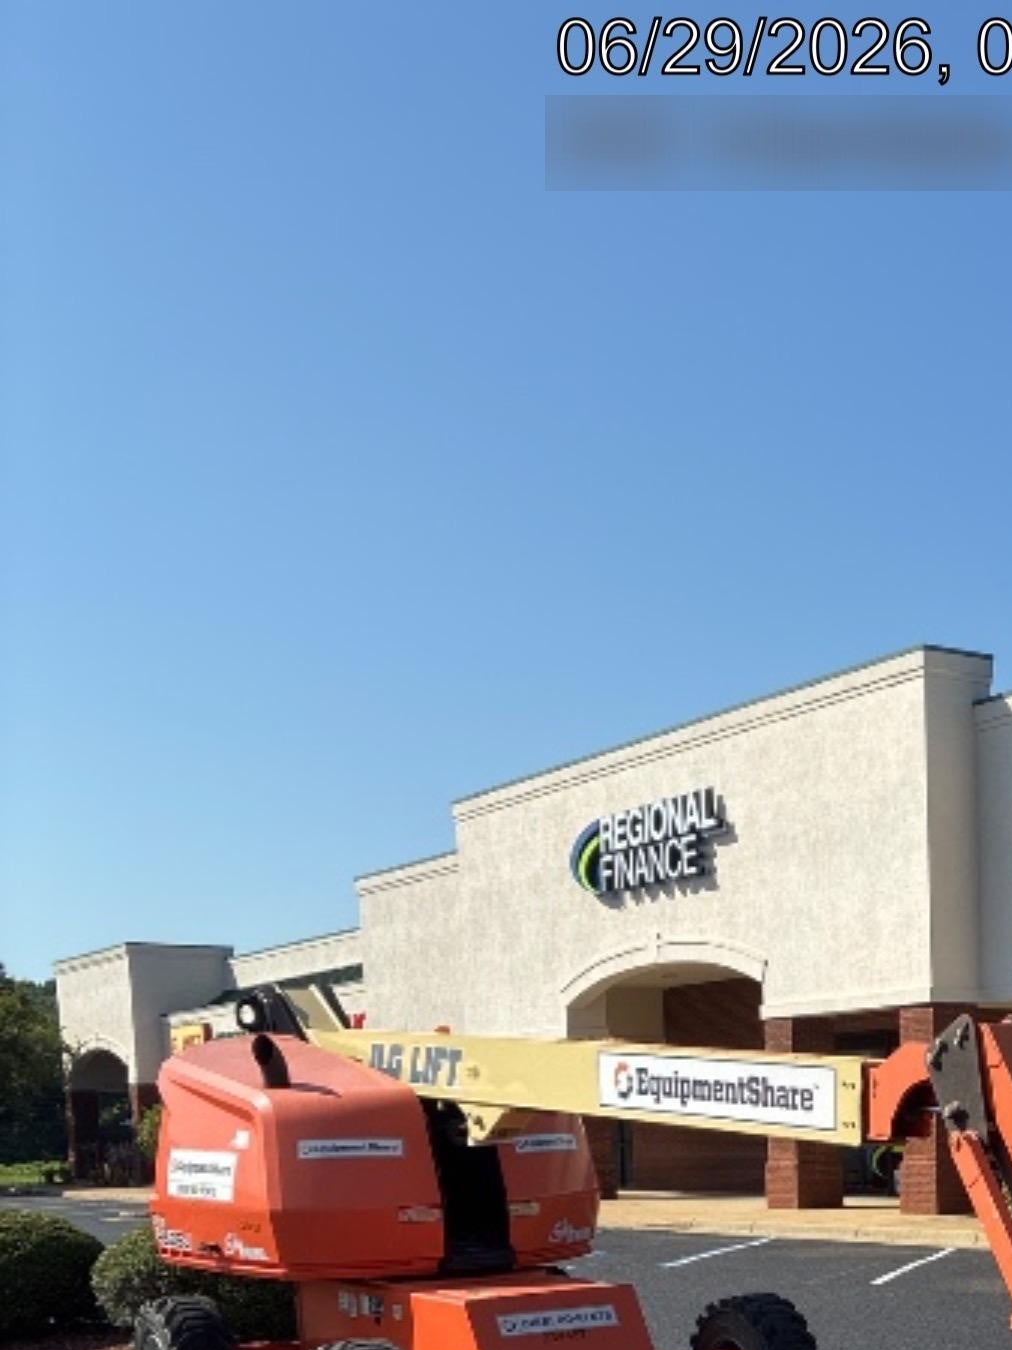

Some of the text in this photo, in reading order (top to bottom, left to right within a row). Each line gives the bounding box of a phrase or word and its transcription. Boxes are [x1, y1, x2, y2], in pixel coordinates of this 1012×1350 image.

[600, 786, 719, 852] REGIONAL
[601, 833, 699, 892] FINANCE
[408, 1046, 463, 1086] LIFT
[635, 1066, 815, 1112] EquipmentShare
